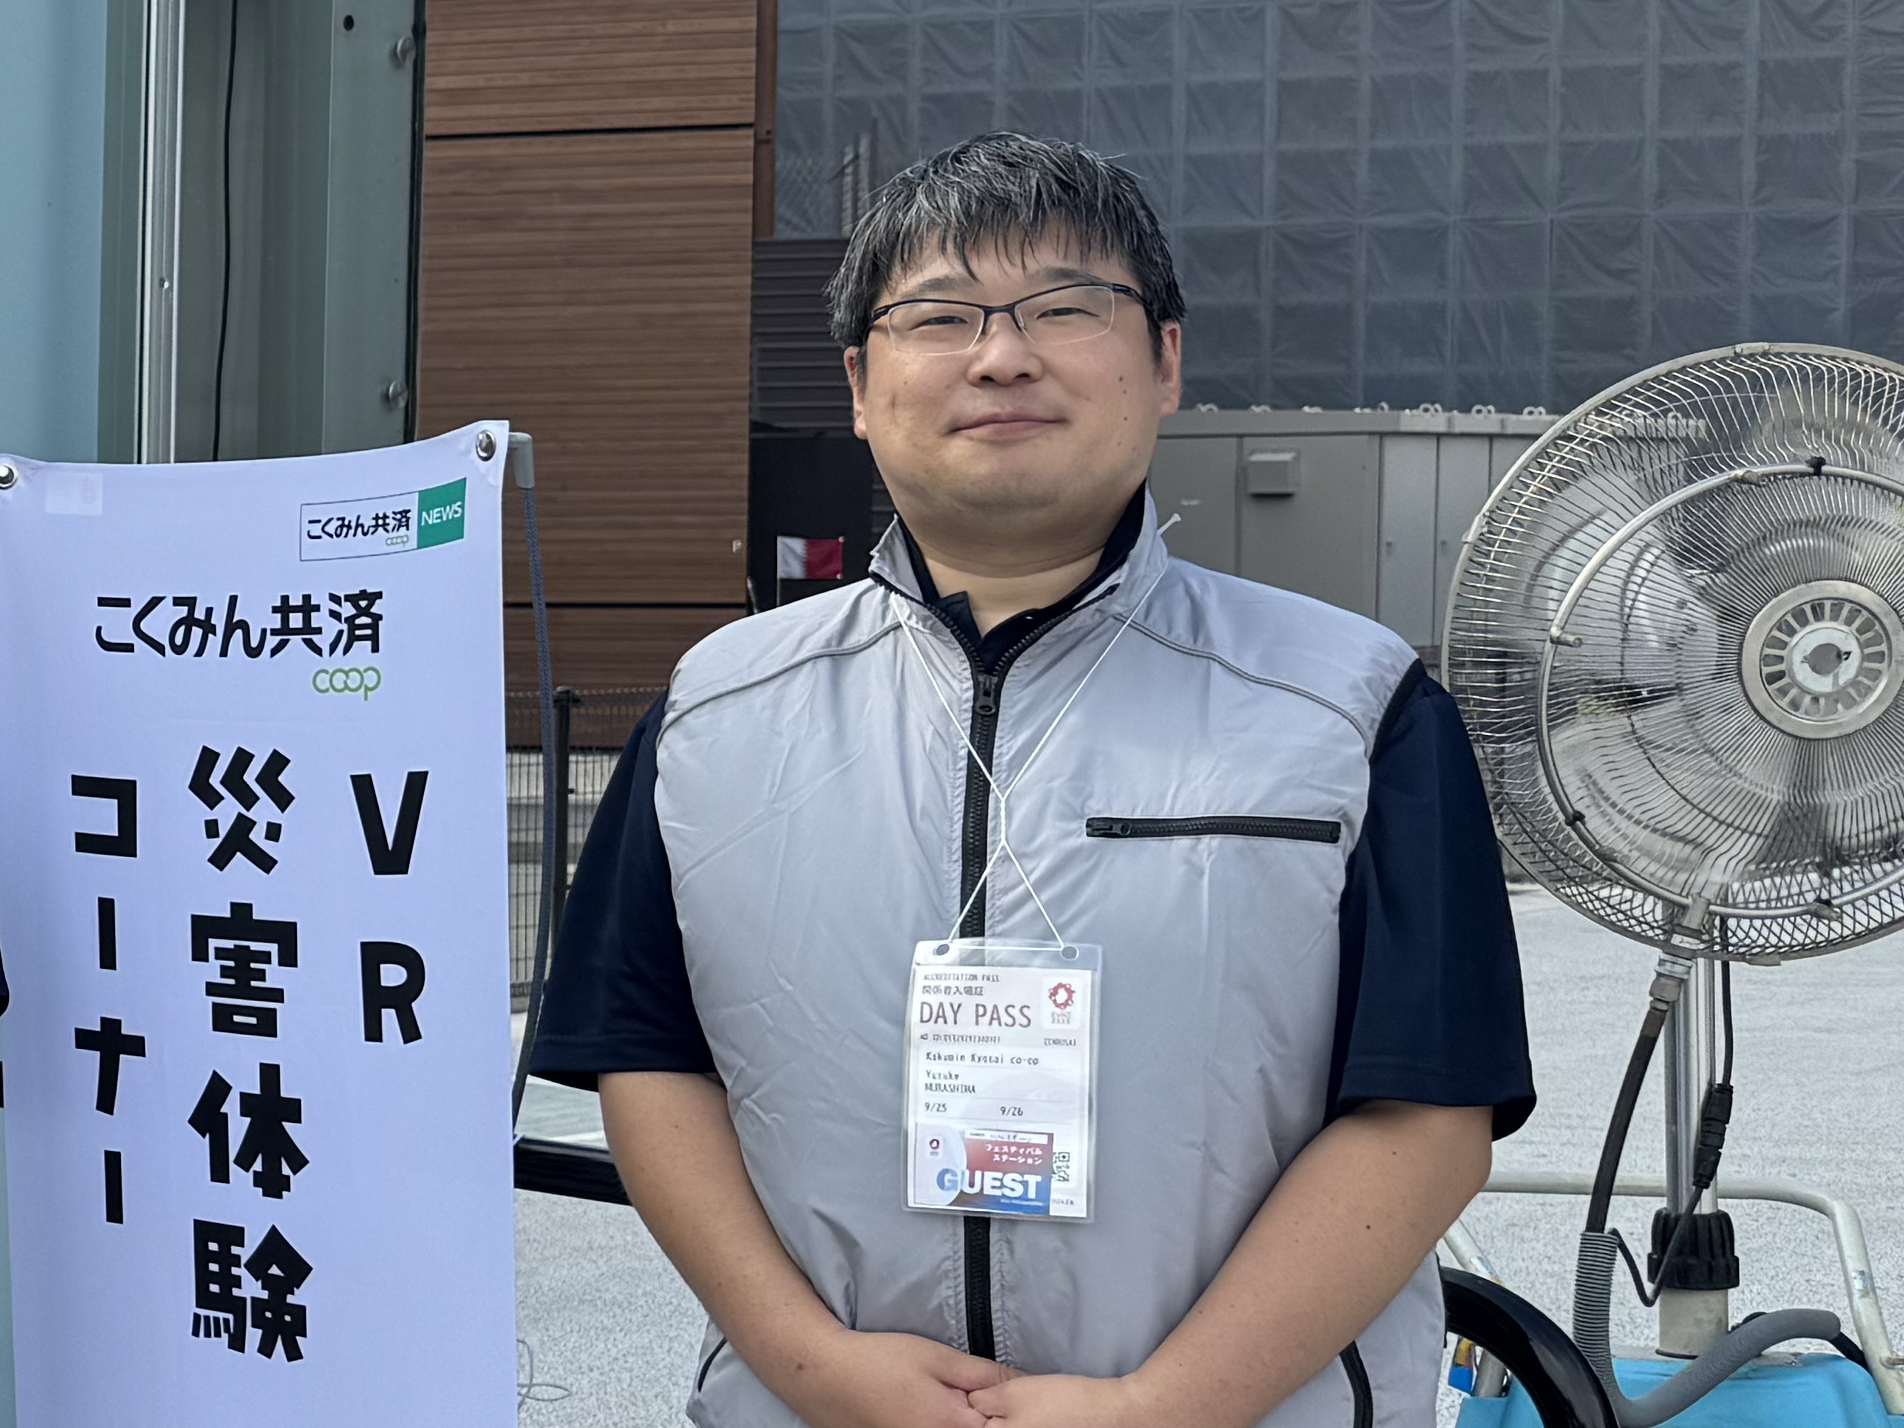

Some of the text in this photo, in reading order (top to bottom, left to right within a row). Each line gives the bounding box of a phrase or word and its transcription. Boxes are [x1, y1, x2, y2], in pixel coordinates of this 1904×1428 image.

[306, 501, 463, 540] こくみん共済 NEWS
[95, 588, 384, 659] こくみん共済
[70, 773, 147, 1225] コーナー
[919, 1001, 963, 1026] DAY
[974, 1003, 1032, 1029] PASS
[188, 745, 314, 1364] 災害体験
[936, 1167, 1042, 1200] GUEST
